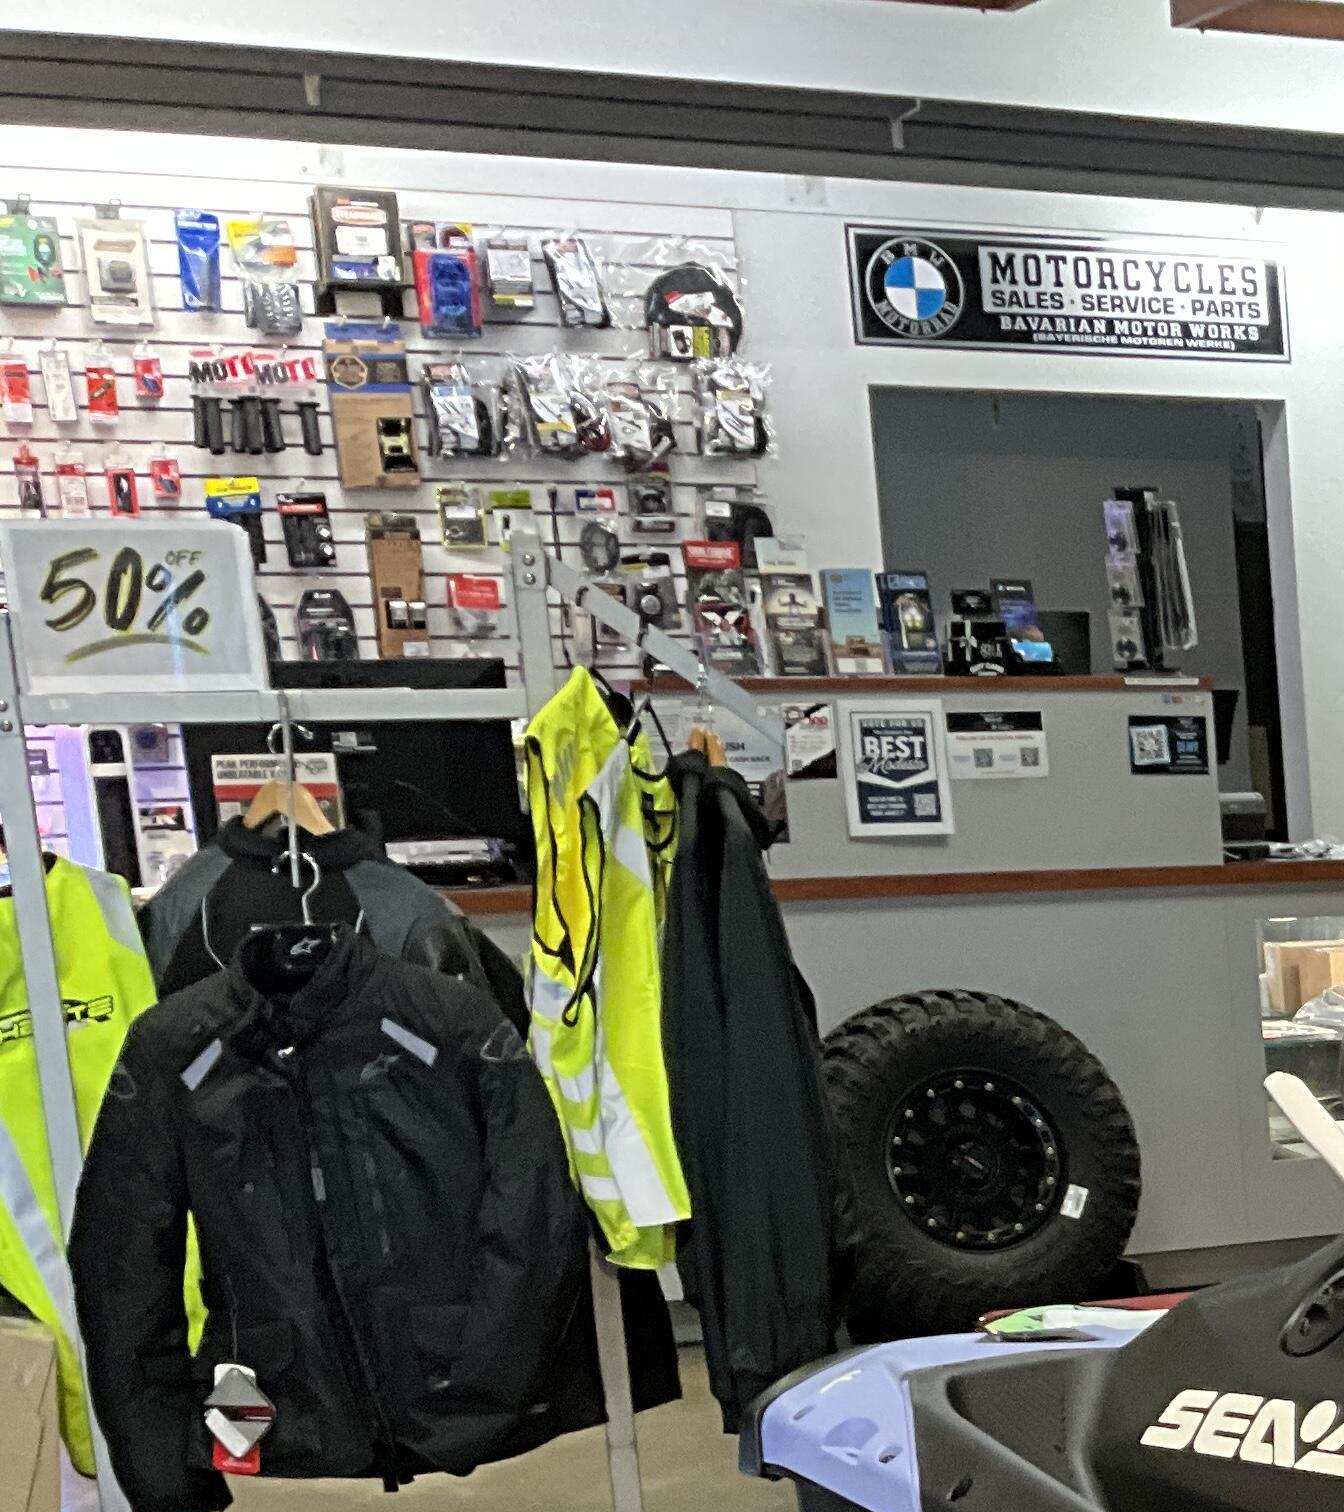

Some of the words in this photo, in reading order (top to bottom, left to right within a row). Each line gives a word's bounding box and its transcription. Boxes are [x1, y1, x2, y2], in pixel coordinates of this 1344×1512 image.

[880, 243, 945, 267] BMW
[988, 251, 1259, 297] MOTORCYCLES
[875, 299, 958, 336] MOTORRAD
[992, 290, 1064, 311] SALES
[1081, 293, 1175, 315] SERVICE
[1191, 300, 1261, 319] PARTS
[1000, 314, 1110, 335] BAVARIAN
[1115, 318, 1182, 338] MOTOR
[1188, 323, 1260, 341] WORKS
[165, 550, 202, 566] OFF
[40, 546, 210, 636] 50%
[863, 735, 926, 759] BEST
